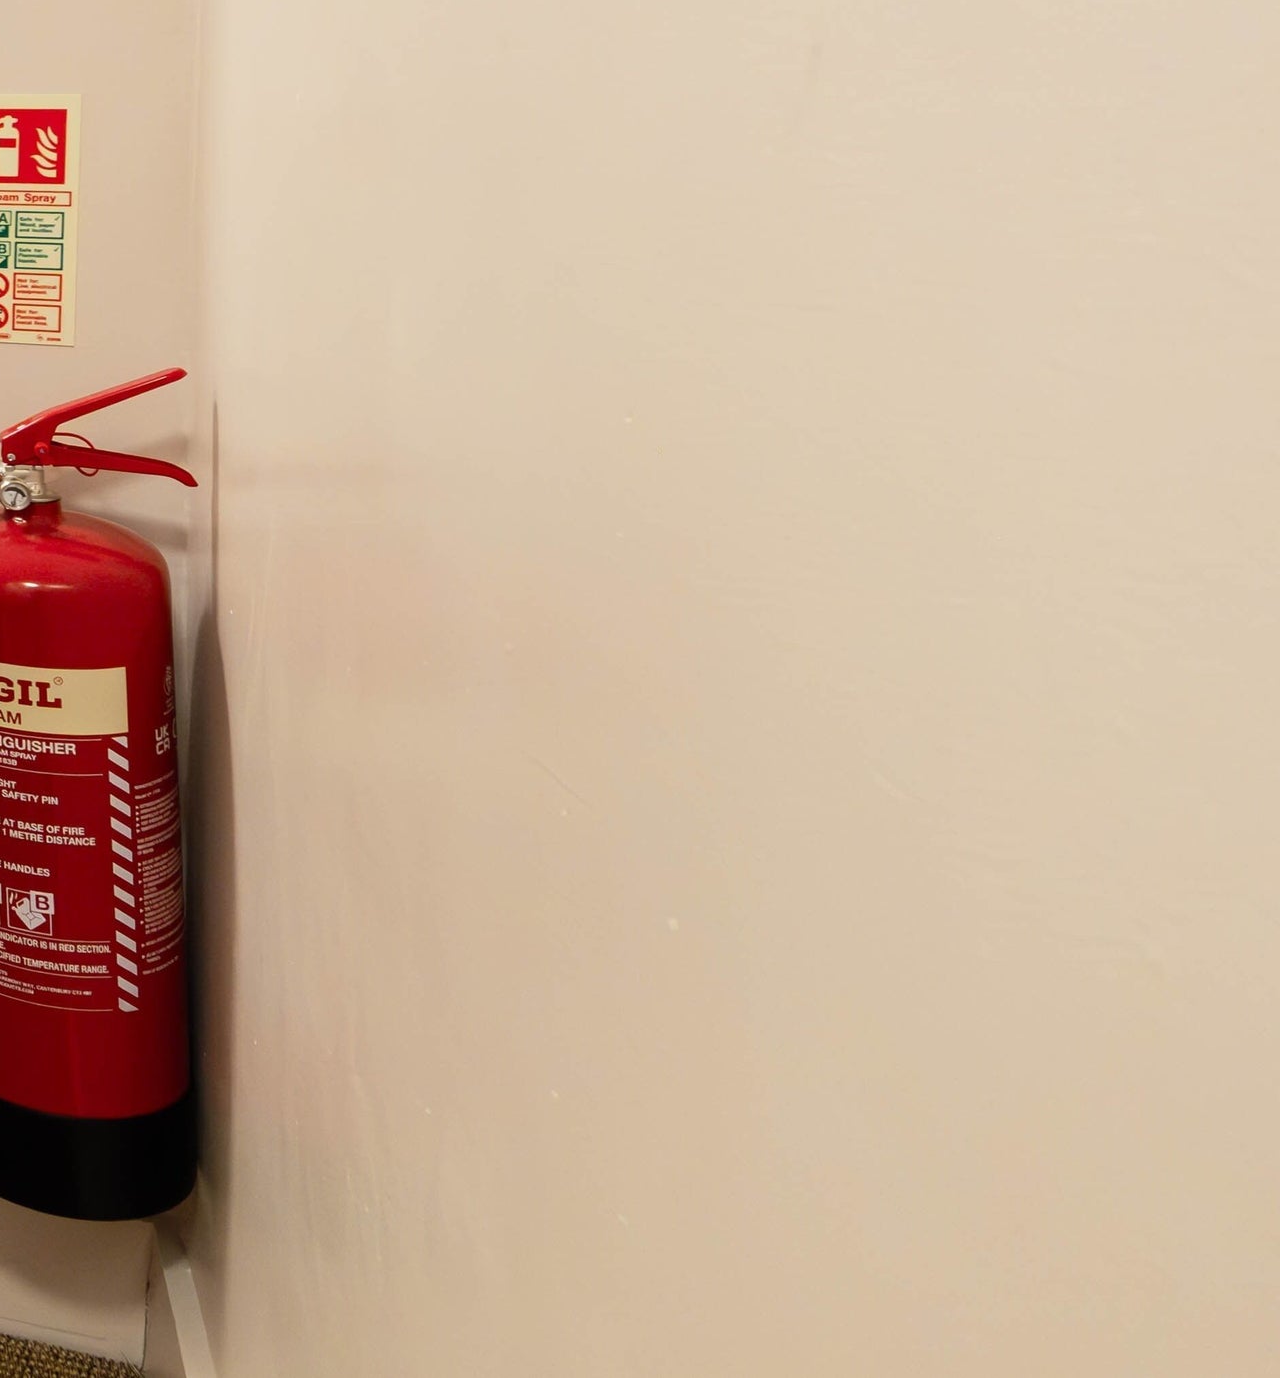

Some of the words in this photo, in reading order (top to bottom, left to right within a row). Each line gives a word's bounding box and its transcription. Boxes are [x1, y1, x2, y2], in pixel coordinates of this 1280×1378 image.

[24, 193, 56, 203] Spray
[155, 723, 169, 741] UK
[155, 737, 171, 755] CA
[9, 750, 37, 761] SPRAY
[1, 788, 39, 804] SAFETY
[41, 795, 60, 806] PIN
[2, 817, 16, 828] AT
[17, 820, 44, 833] BASE
[46, 824, 60, 835] OF
[62, 826, 85, 836] FIRE
[1, 827, 7, 836] 1
[9, 830, 44, 843] METRE
[46, 834, 97, 847] DISTANCE
[3, 860, 51, 878] HANDLES
[35, 895, 50, 911] B
[40, 940, 48, 950] IS
[49, 941, 58, 951] IN
[58, 943, 75, 953] RED
[76, 944, 111, 954] SECTION.
[22, 957, 80, 974] TEMPERATURE
[81, 965, 109, 974] RANGE.
